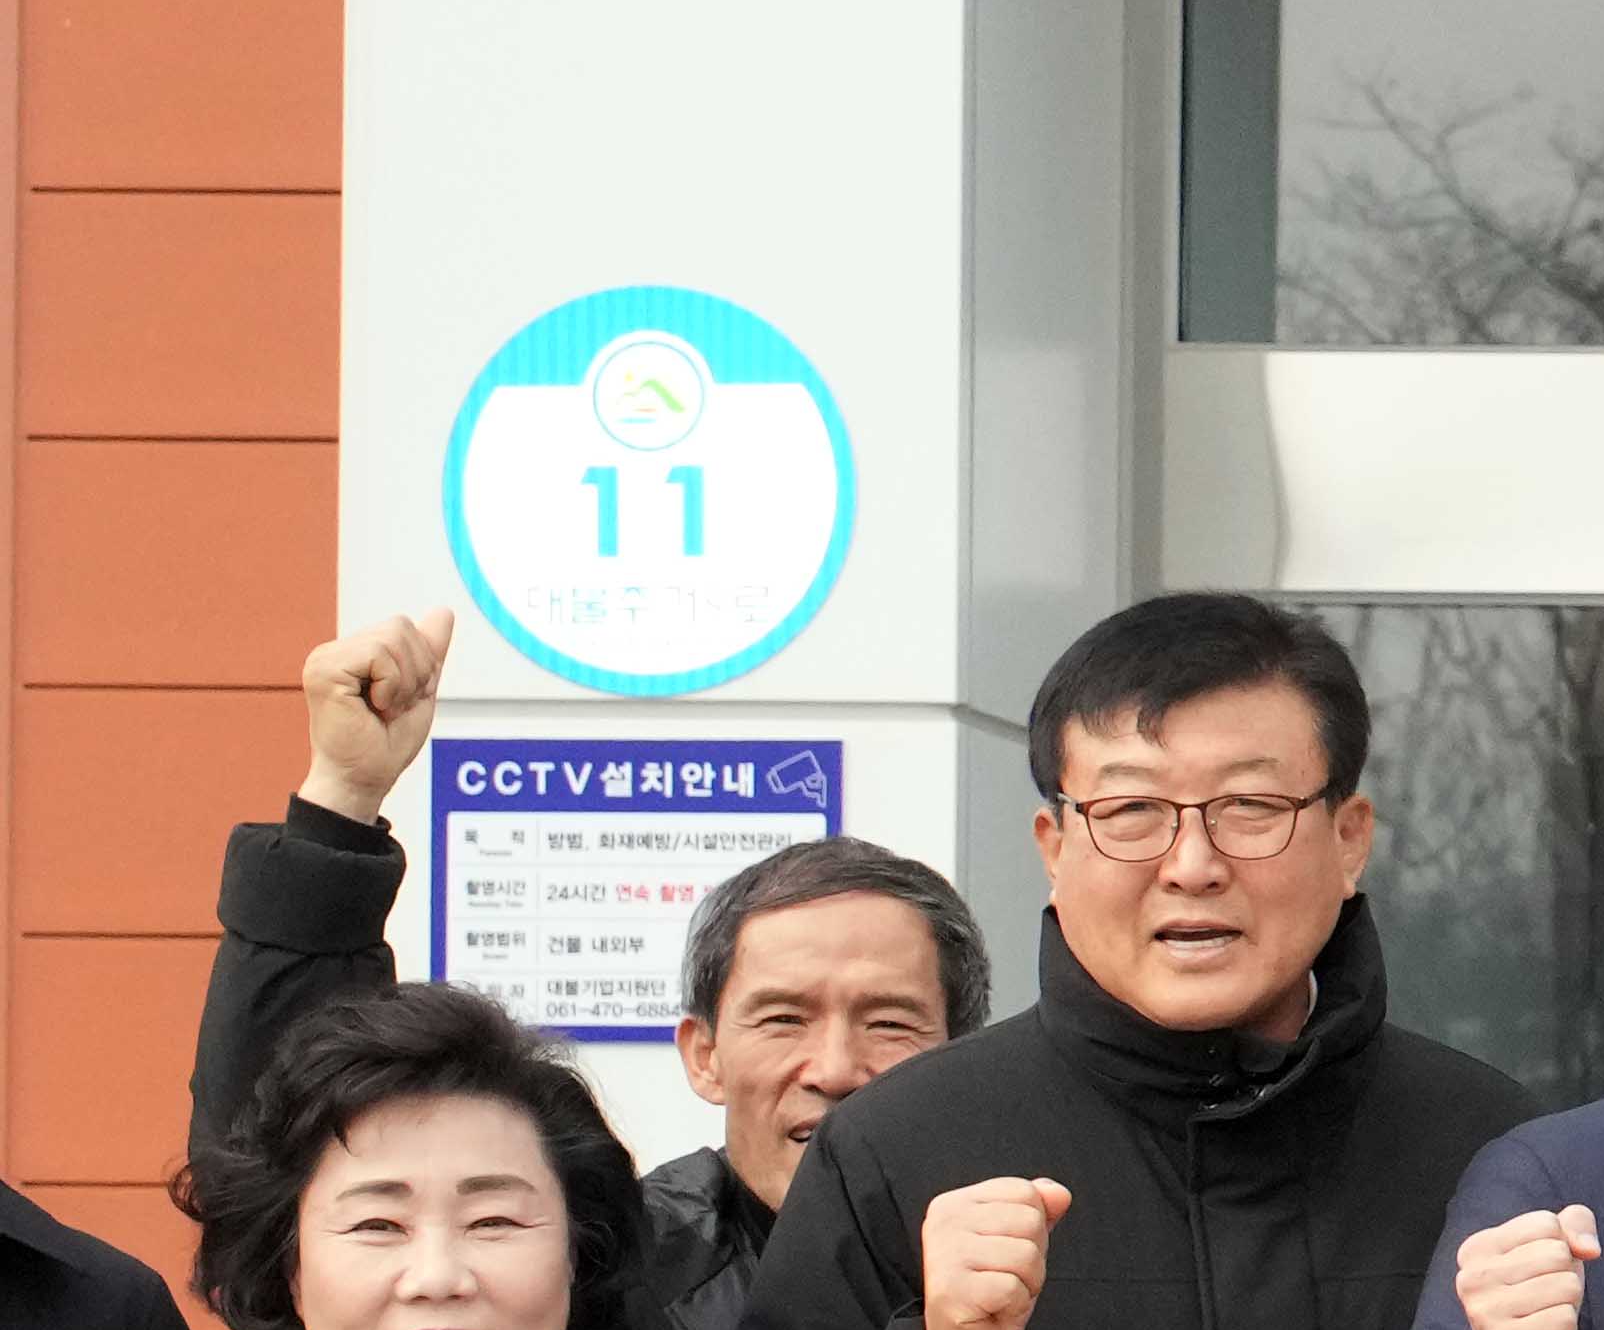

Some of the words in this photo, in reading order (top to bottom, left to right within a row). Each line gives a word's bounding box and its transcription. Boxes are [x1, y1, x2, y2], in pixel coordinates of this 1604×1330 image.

[580, 465, 705, 557] 11
[547, 883, 606, 902] 24시간
[615, 883, 650, 902] 연속
[548, 936, 582, 954] 건물
[592, 935, 645, 954] 내외부
